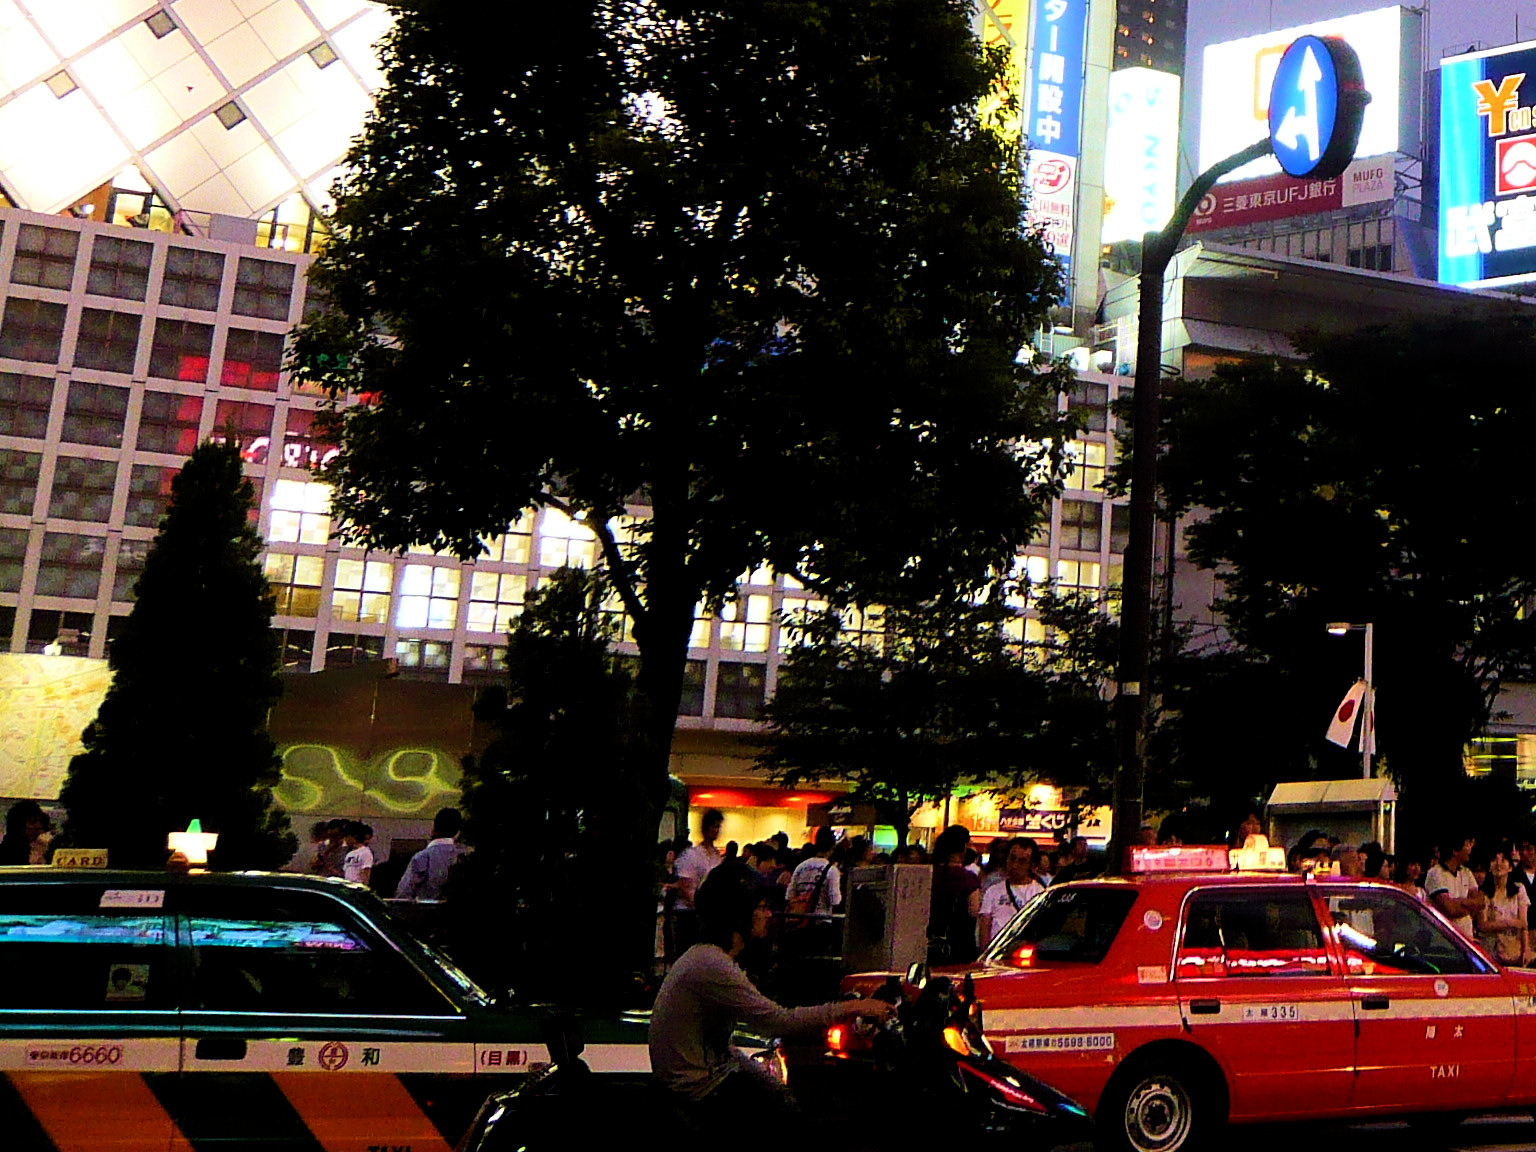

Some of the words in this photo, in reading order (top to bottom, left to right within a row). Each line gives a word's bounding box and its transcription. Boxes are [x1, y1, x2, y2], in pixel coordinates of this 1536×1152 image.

[1352, 167, 1384, 182] MUFG
[1352, 180, 1383, 195] PLAZA
[1223, 177, 1337, 215] 三菱東京UFJ銀行
[56, 856, 105, 867] CARD
[1271, 1005, 1297, 1019] 335
[69, 1047, 121, 1065] 6660
[361, 1047, 381, 1067] 和
[1430, 1065, 1460, 1078] TAXI
